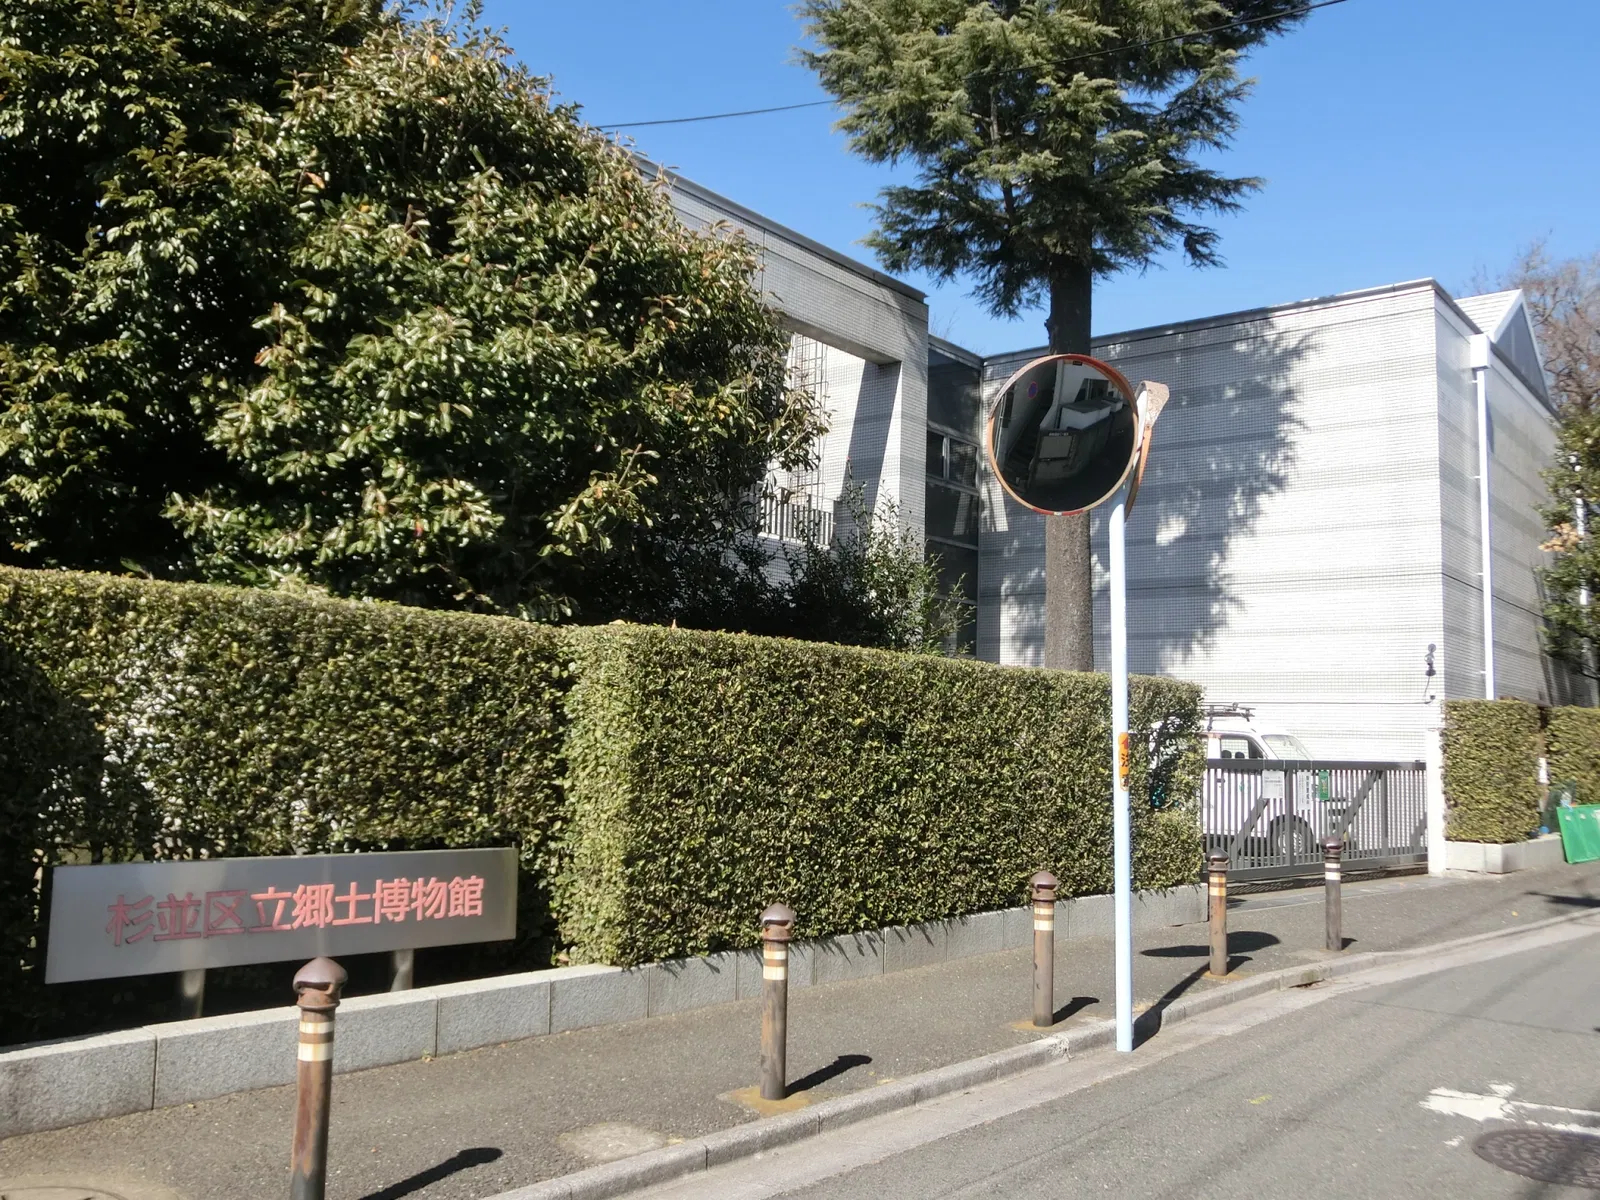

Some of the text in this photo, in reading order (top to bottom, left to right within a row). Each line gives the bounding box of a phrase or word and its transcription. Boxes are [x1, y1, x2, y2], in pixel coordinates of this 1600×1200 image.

[106, 875, 484, 946] 杉並区立郷土博物館
